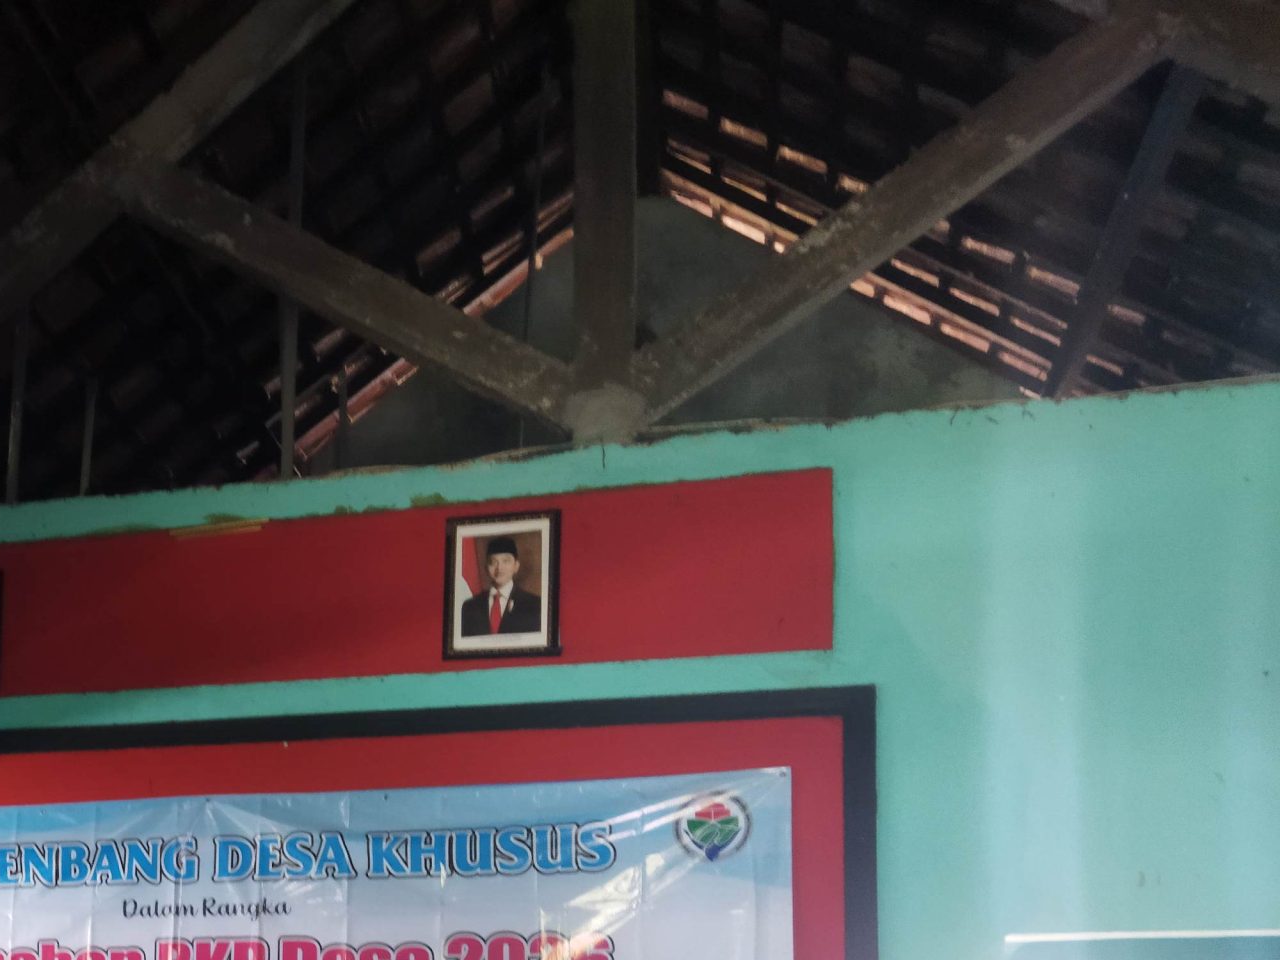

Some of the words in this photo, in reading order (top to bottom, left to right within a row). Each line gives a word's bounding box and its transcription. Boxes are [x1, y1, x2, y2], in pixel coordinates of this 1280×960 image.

[214, 829, 357, 881] DESA
[366, 821, 617, 878] KHUSUS
[123, 898, 198, 918] Dalam
[202, 897, 291, 921] Rangka
